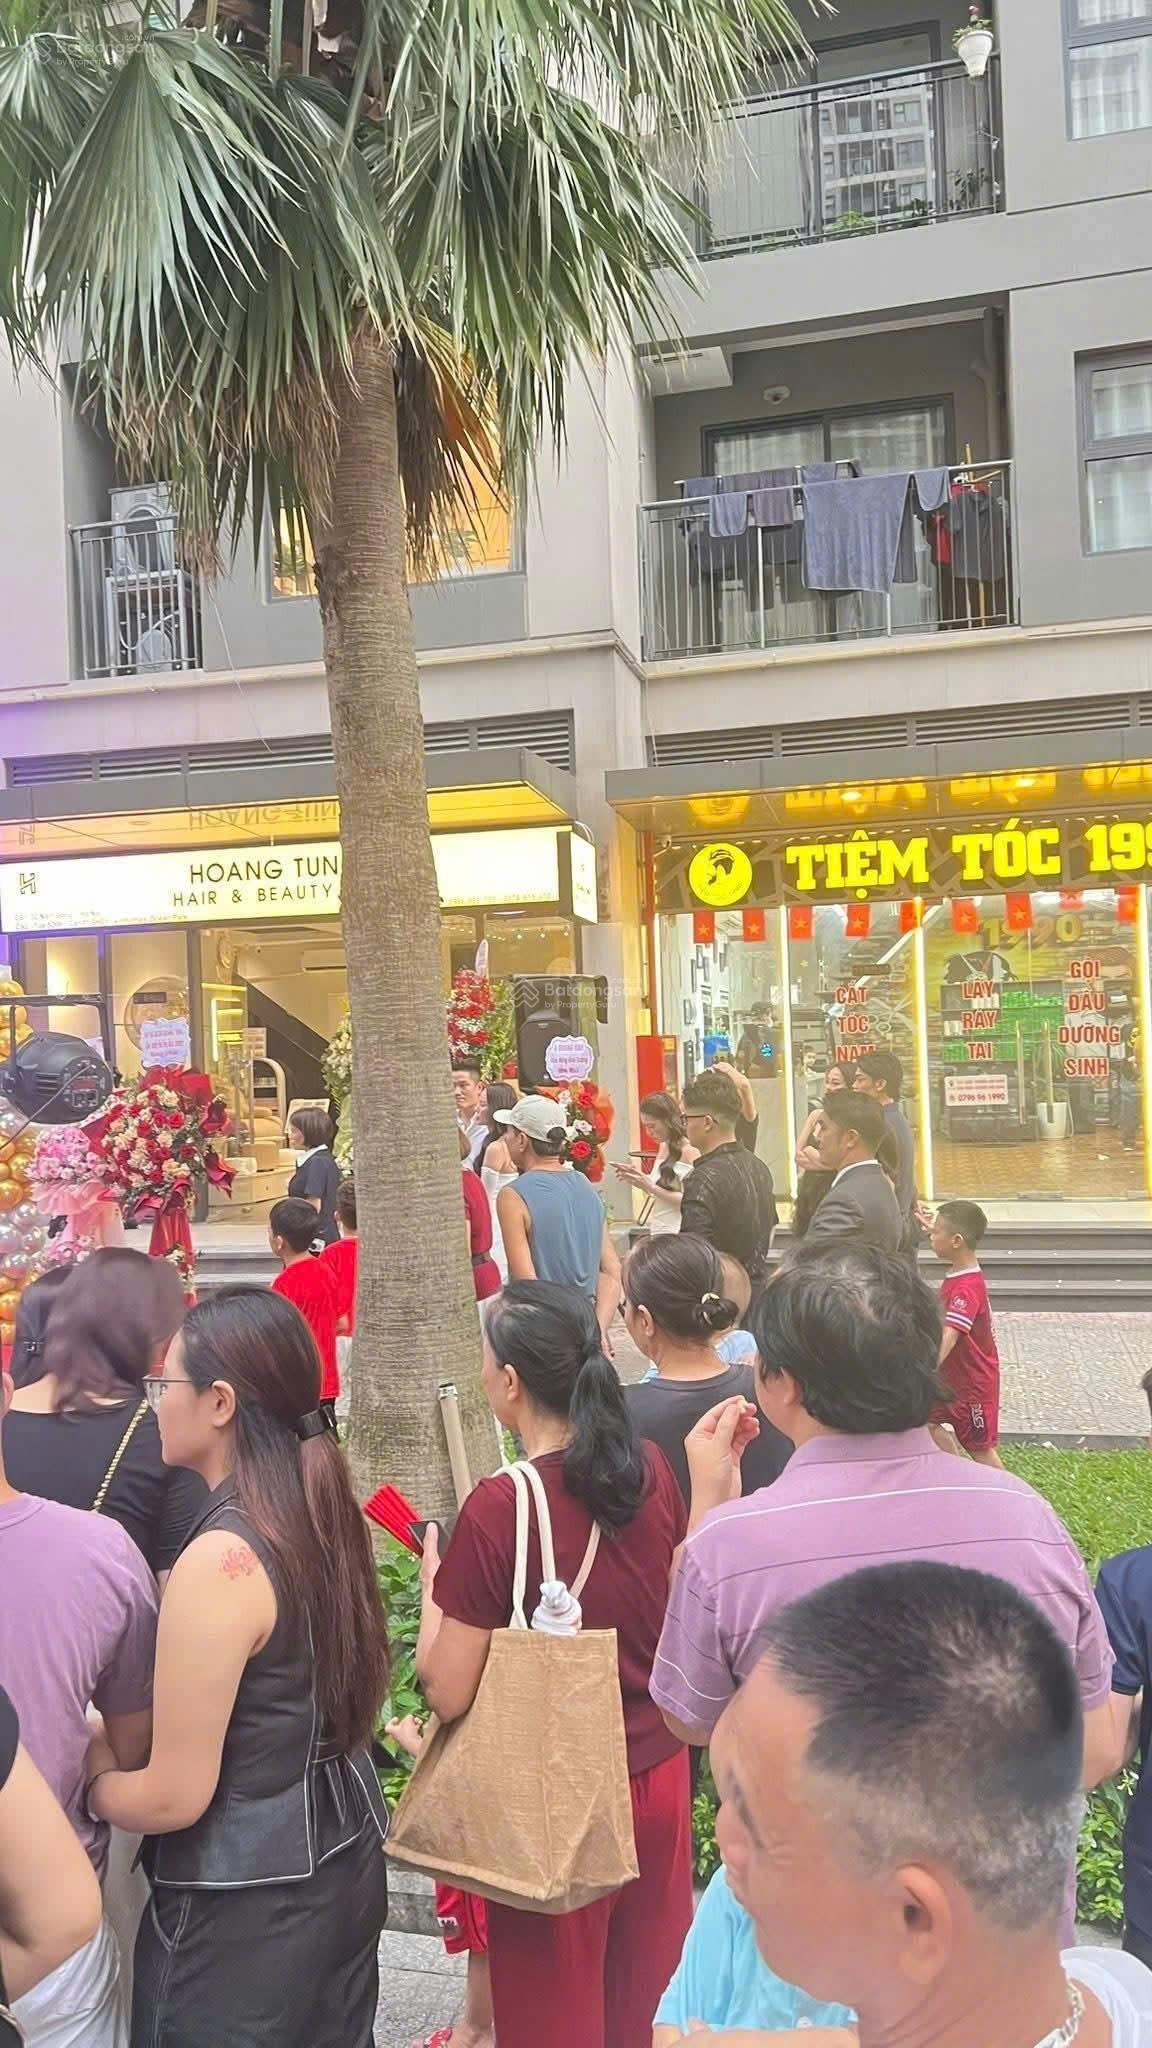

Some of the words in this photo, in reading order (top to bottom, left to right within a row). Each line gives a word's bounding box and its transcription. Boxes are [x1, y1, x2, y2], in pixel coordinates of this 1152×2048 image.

[785, 829, 930, 900] TIỆM
[951, 817, 1061, 881] TÓC
[1085, 822, 1152, 872] 19
[190, 859, 283, 884] HOANG
[173, 890, 217, 907] HAIR
[231, 888, 242, 903] &
[257, 883, 332, 902] BEAUTY
[1064, 1056, 1109, 1077] SINH
